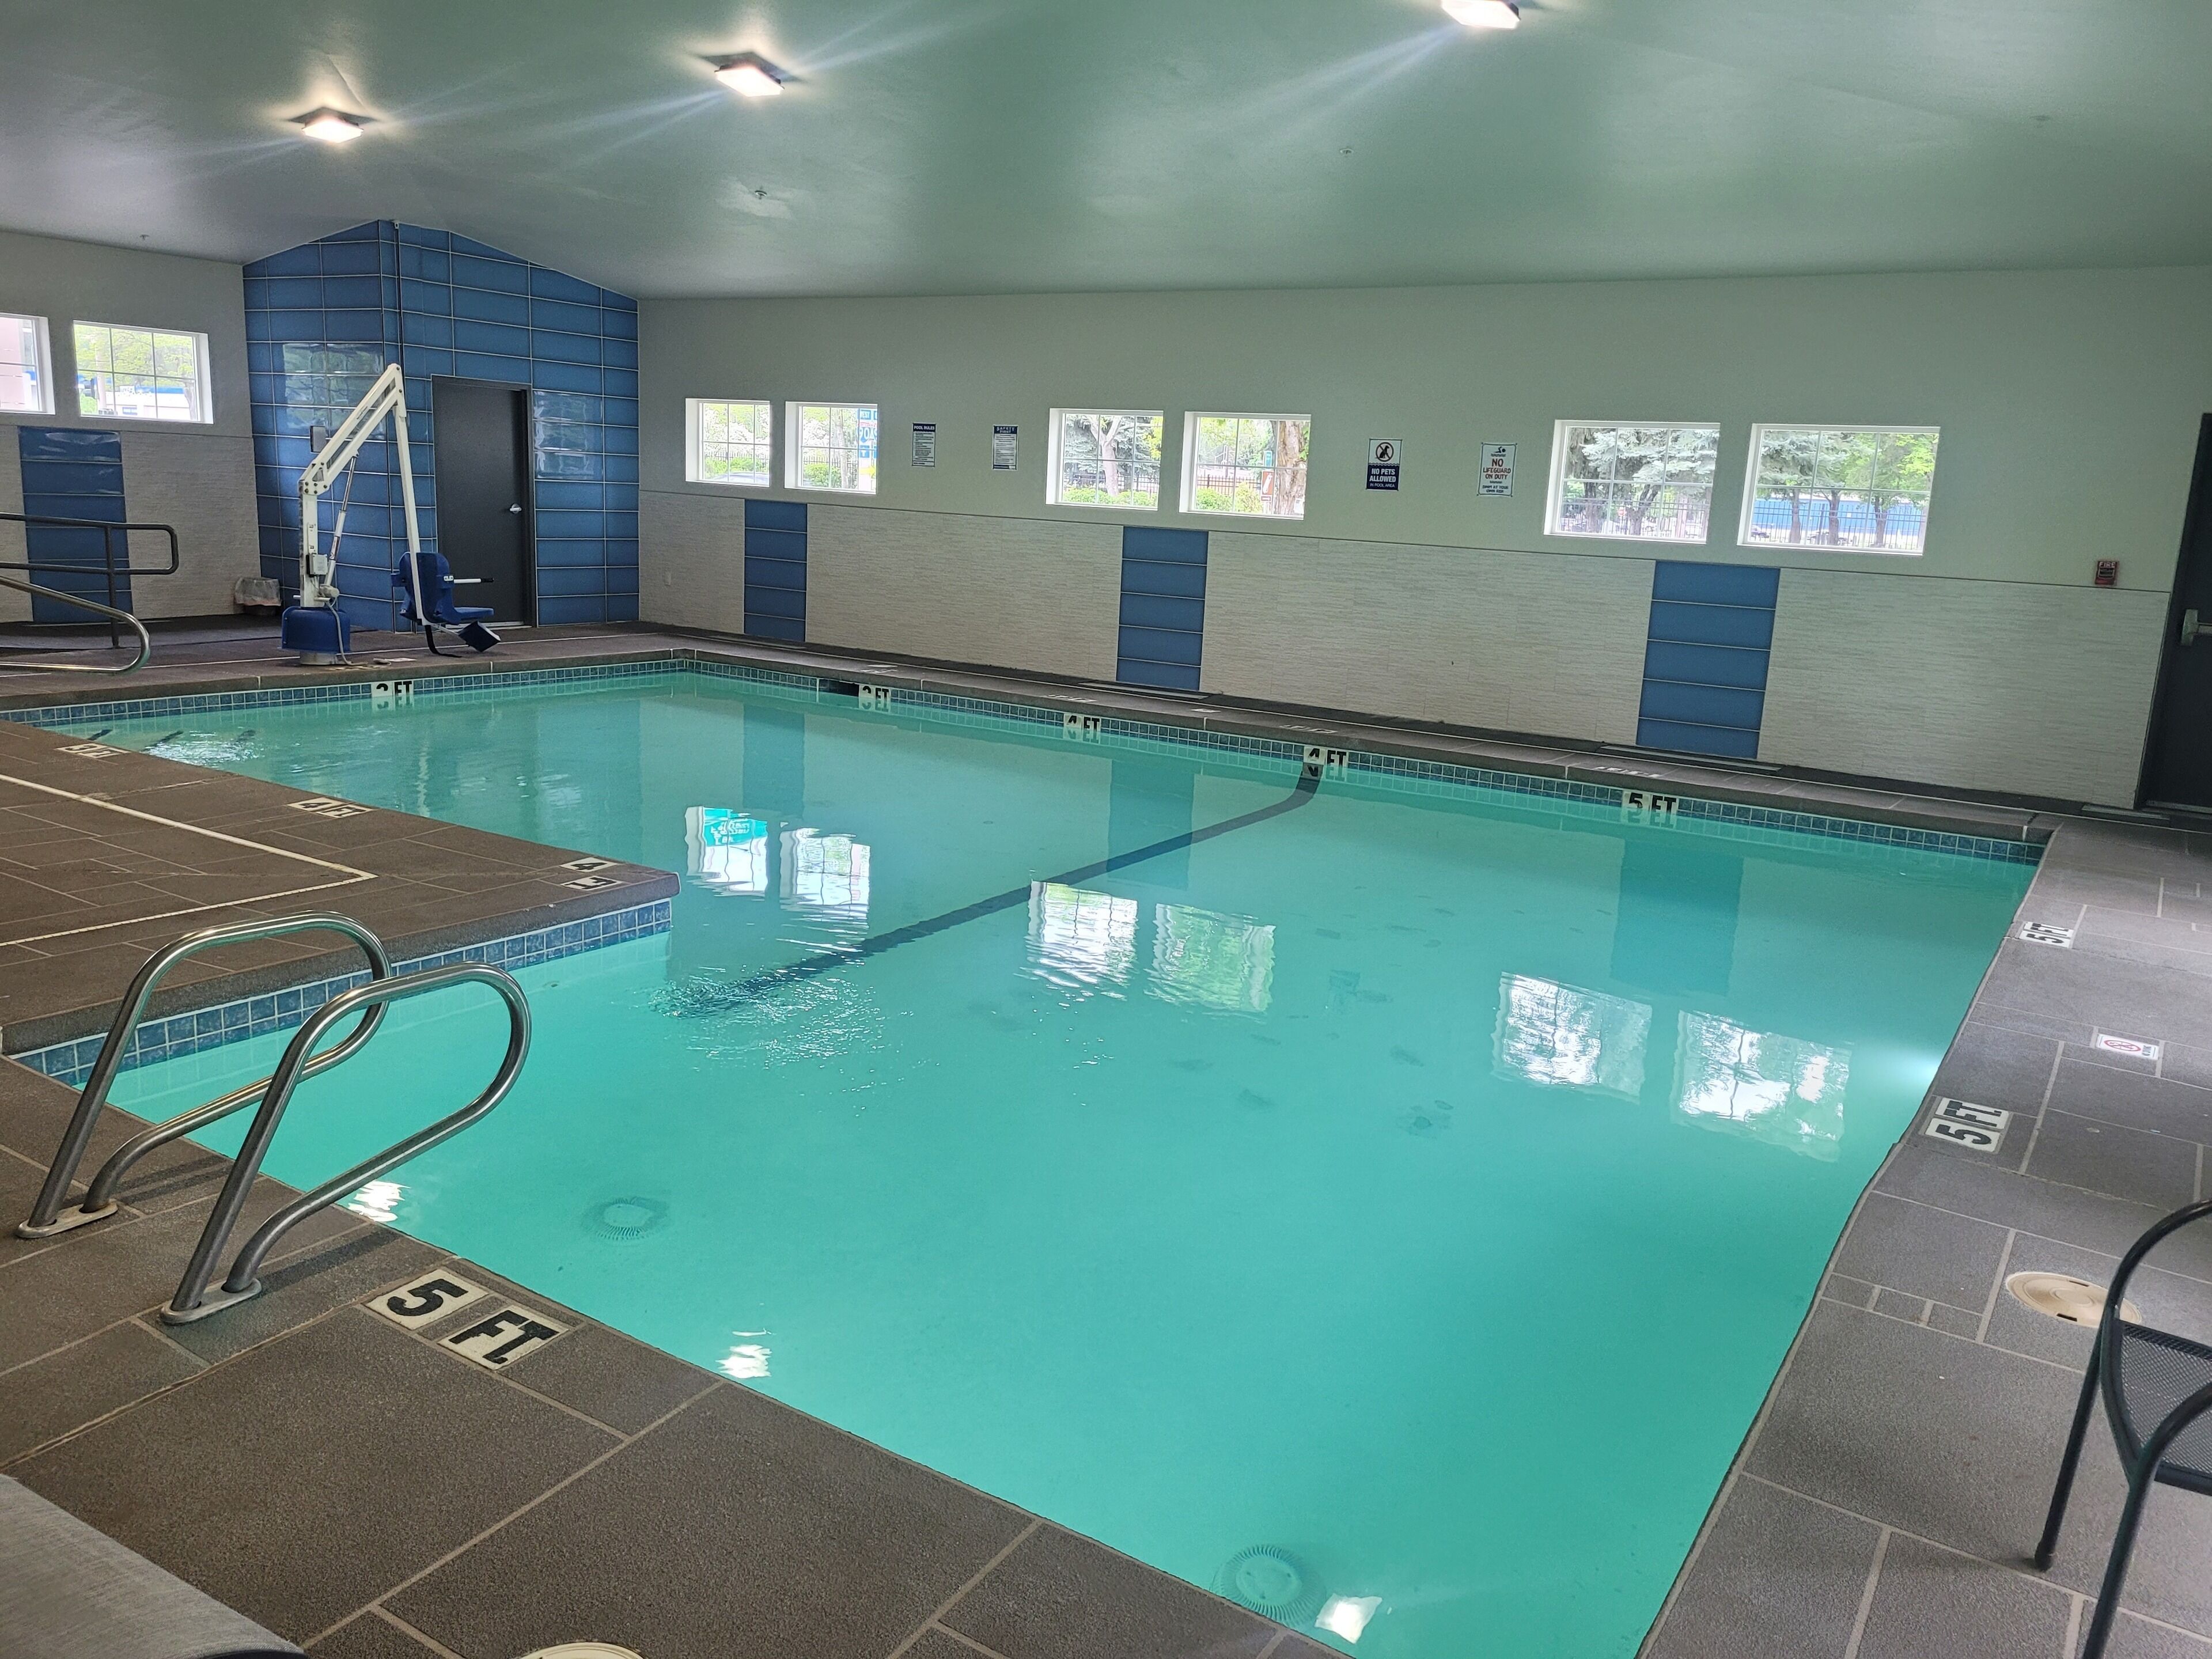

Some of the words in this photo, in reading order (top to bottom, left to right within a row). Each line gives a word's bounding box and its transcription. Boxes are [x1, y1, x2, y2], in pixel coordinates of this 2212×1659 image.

[1492, 459, 1503, 467] NO
[321, 806, 367, 817] FT
[570, 862, 608, 870] 4
[2031, 923, 2069, 937] FT
[2026, 933, 2065, 944] 5
[1943, 1100, 2002, 1128] FT
[1935, 1123, 1992, 1145] 5
[387, 1278, 469, 1317] 5
[448, 1309, 560, 1365] FT
